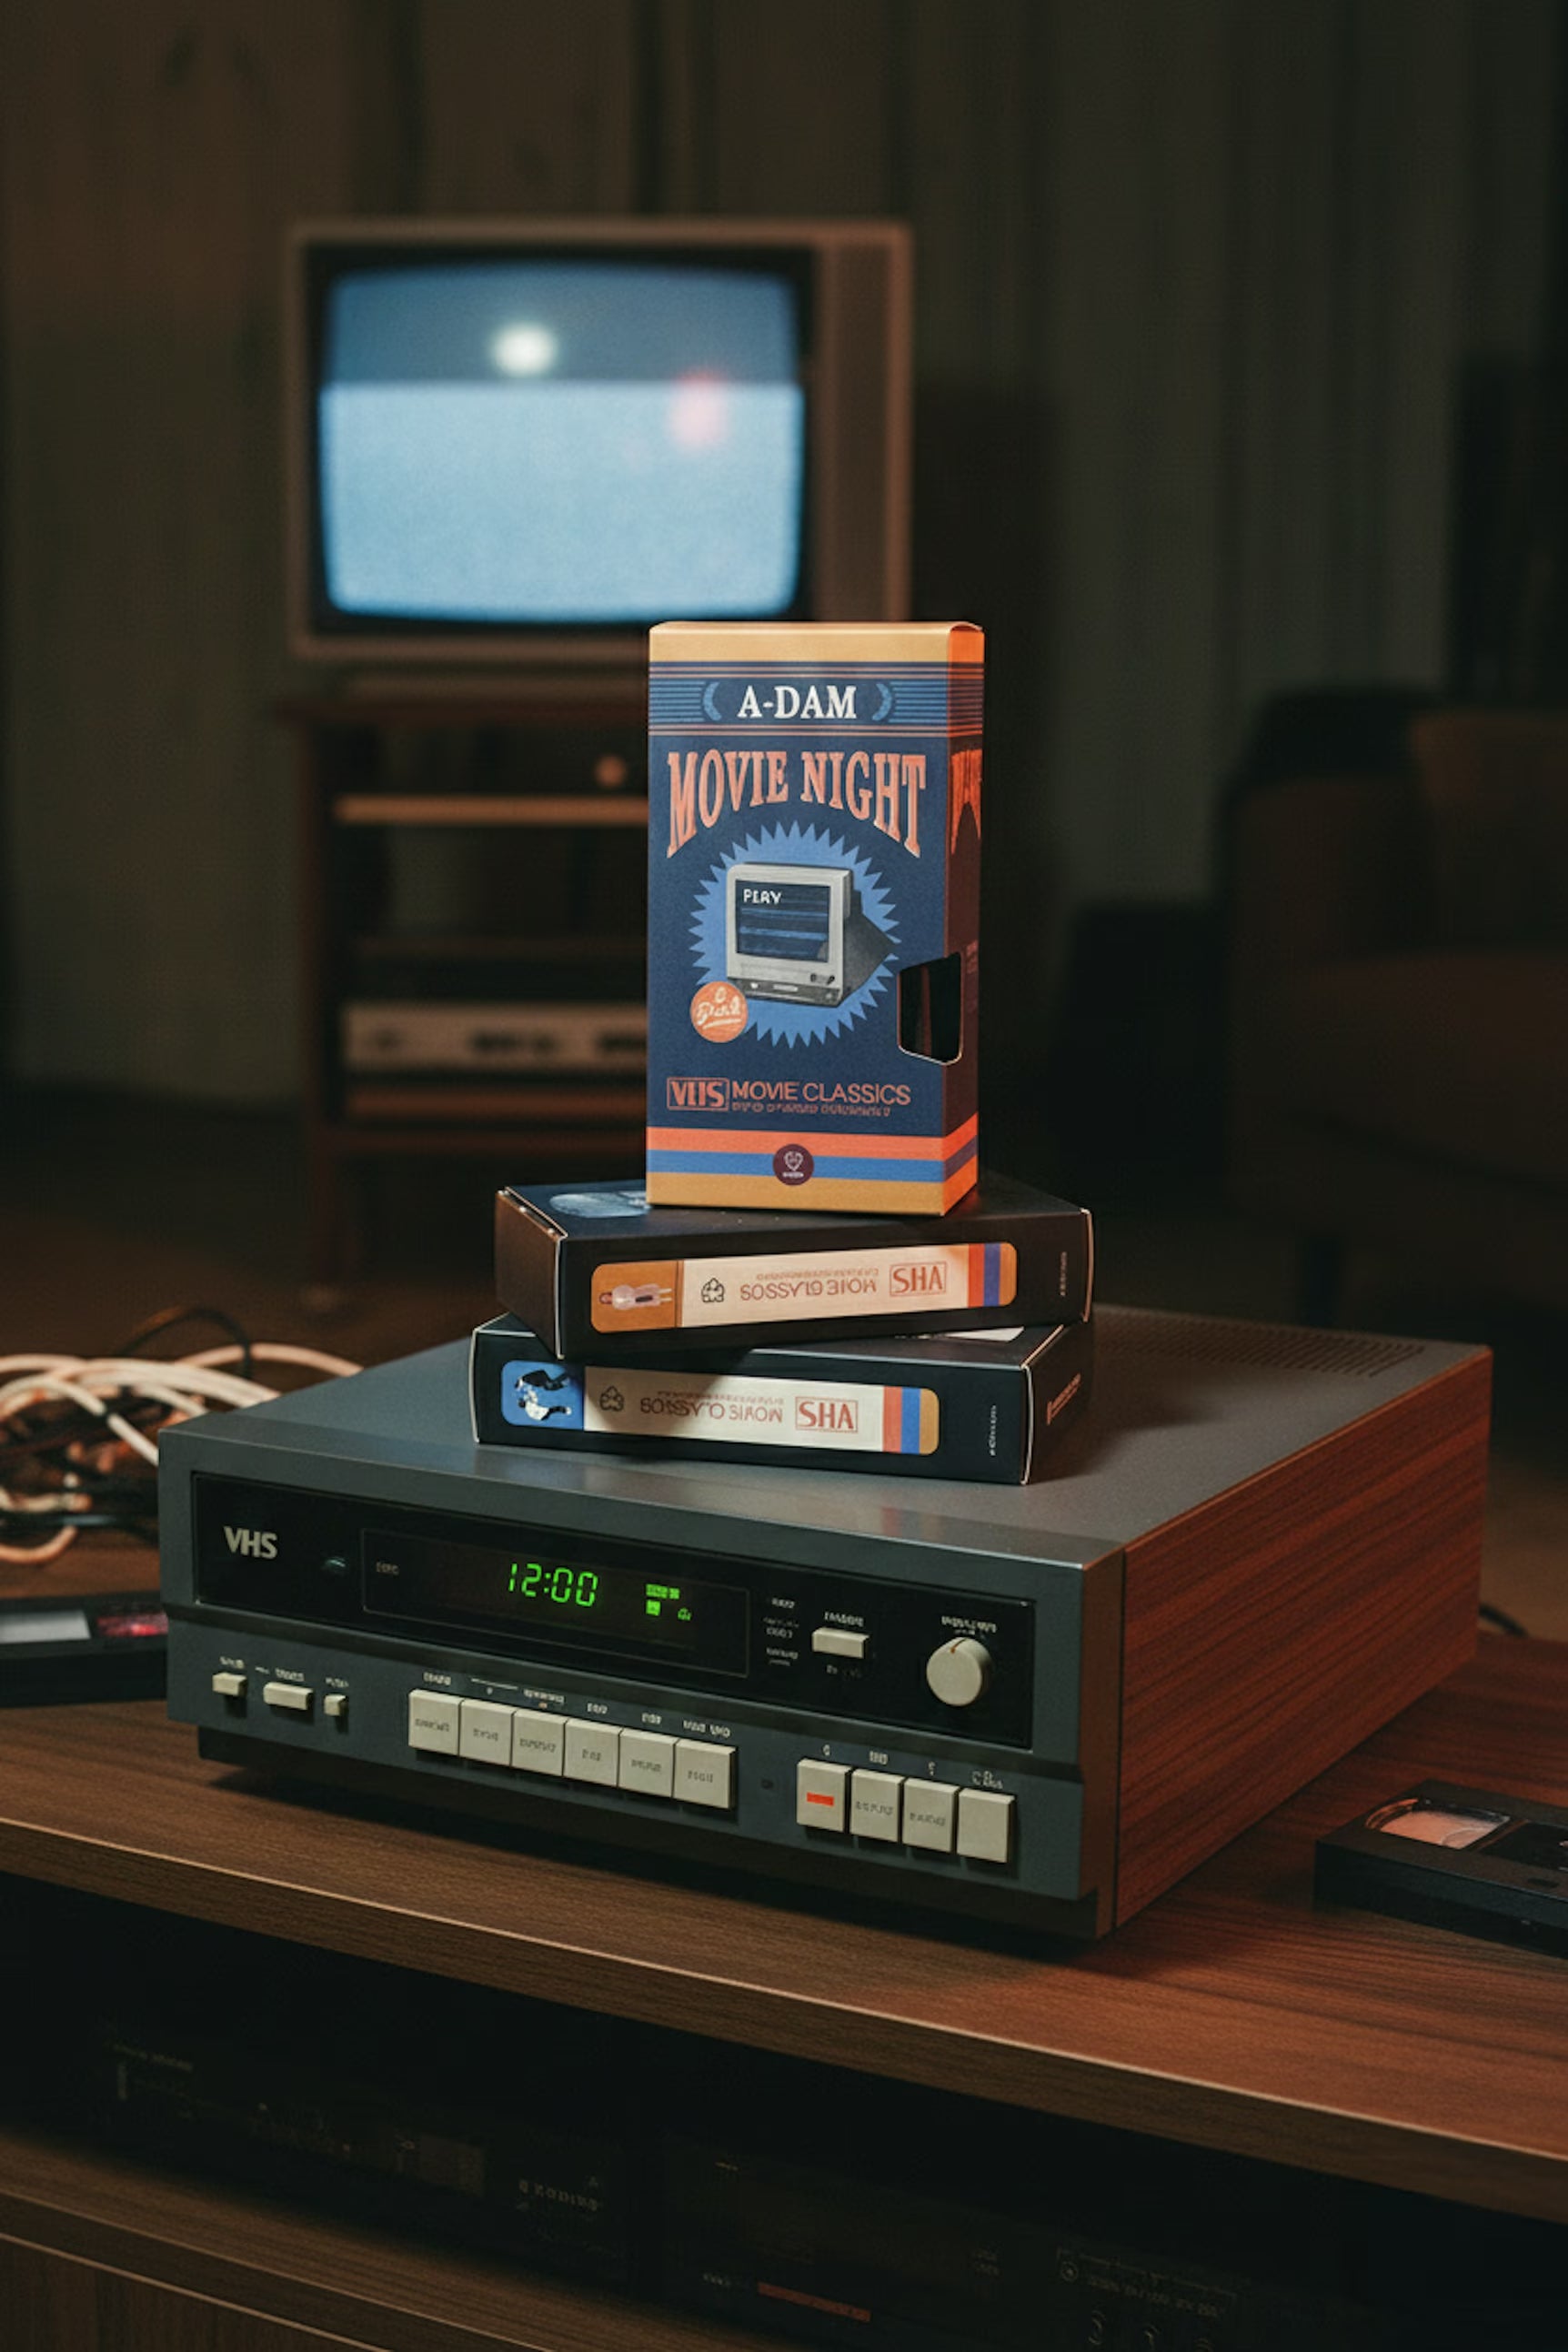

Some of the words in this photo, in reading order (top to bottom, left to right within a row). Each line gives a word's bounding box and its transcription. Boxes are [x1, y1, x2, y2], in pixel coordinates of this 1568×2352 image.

[737, 684, 857, 719] A-DAM
[667, 749, 789, 859] MOVIE
[800, 750, 926, 858] NIGHT
[743, 888, 782, 905] PLAY
[670, 1081, 725, 1107] VHS
[732, 1081, 799, 1101] MOVIE
[802, 1082, 910, 1106] CLASSICS
[223, 1525, 278, 1560] VHS
[508, 1563, 598, 1607] 12:00
